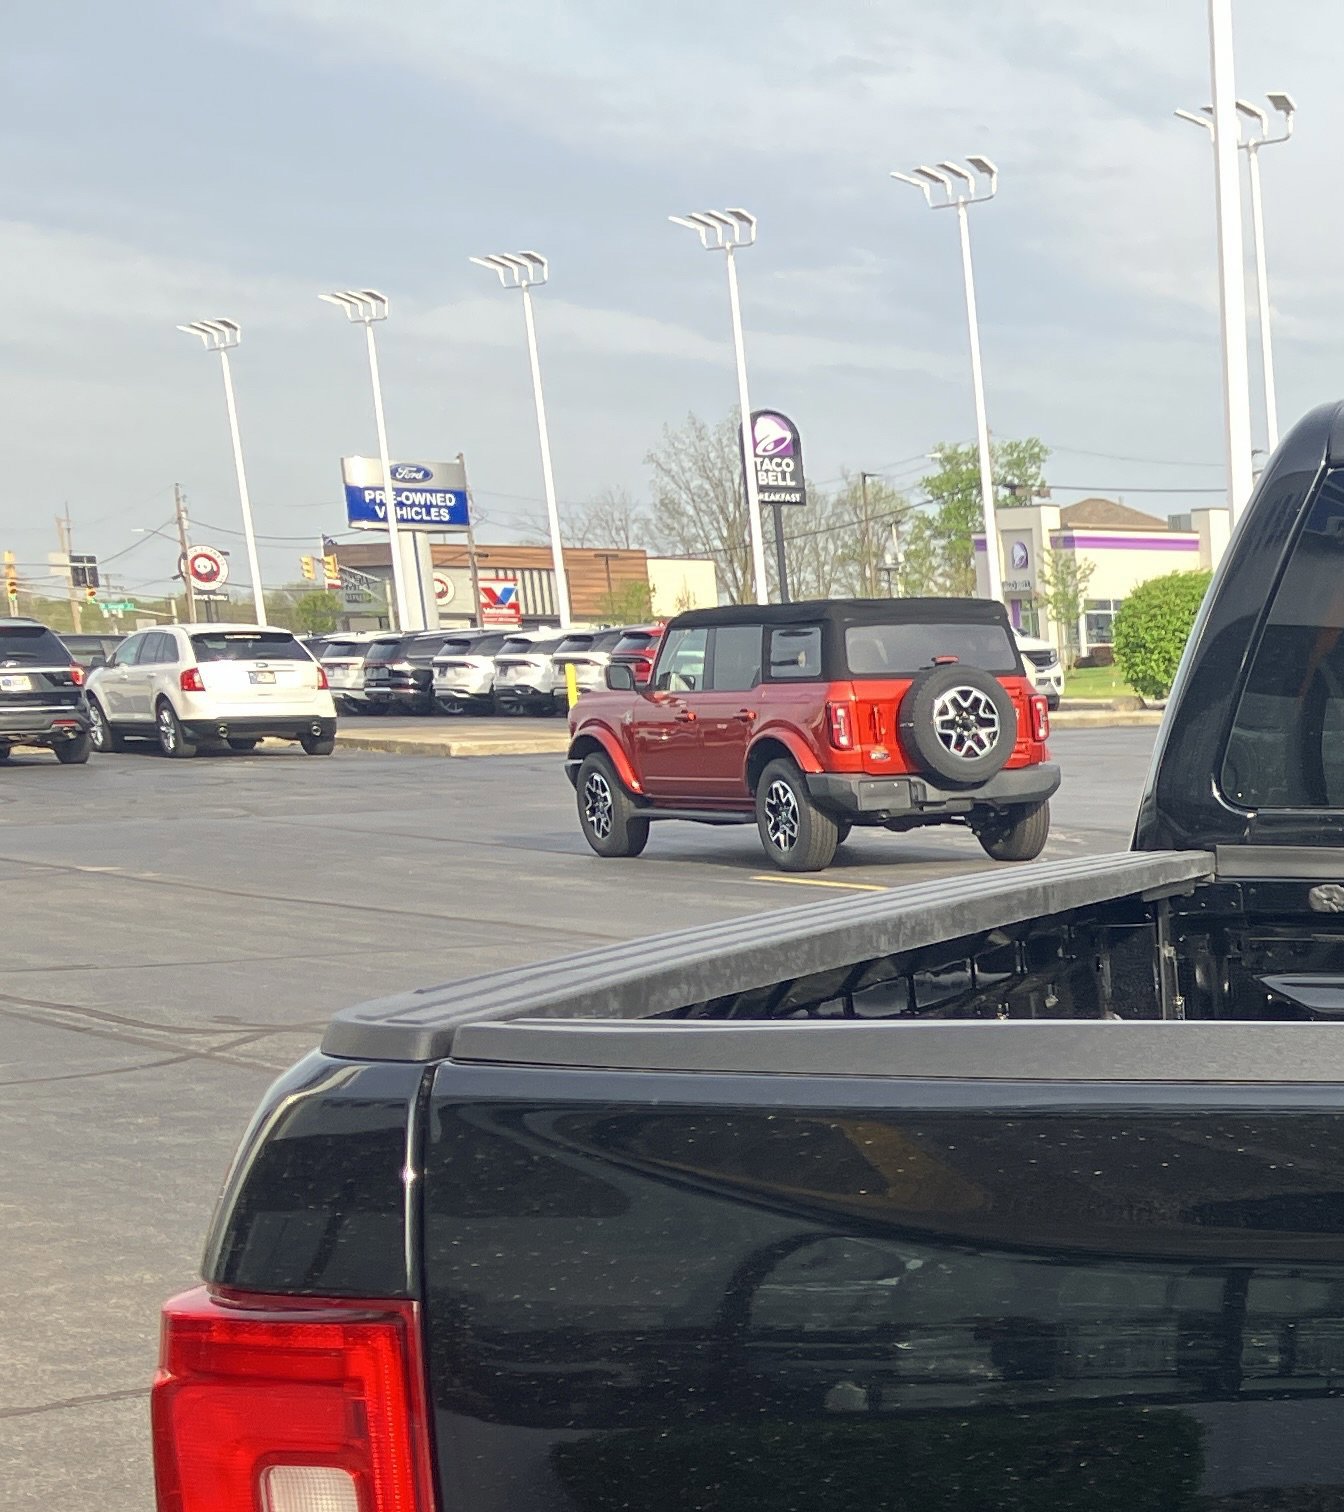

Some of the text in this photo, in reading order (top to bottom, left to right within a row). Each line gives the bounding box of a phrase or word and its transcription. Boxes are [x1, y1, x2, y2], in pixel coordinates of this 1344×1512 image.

[754, 457, 795, 472] TACO
[395, 465, 425, 481] Ford
[758, 471, 796, 486] BELL
[757, 492, 801, 502] REAKFAST
[375, 505, 450, 521] VHICLES
